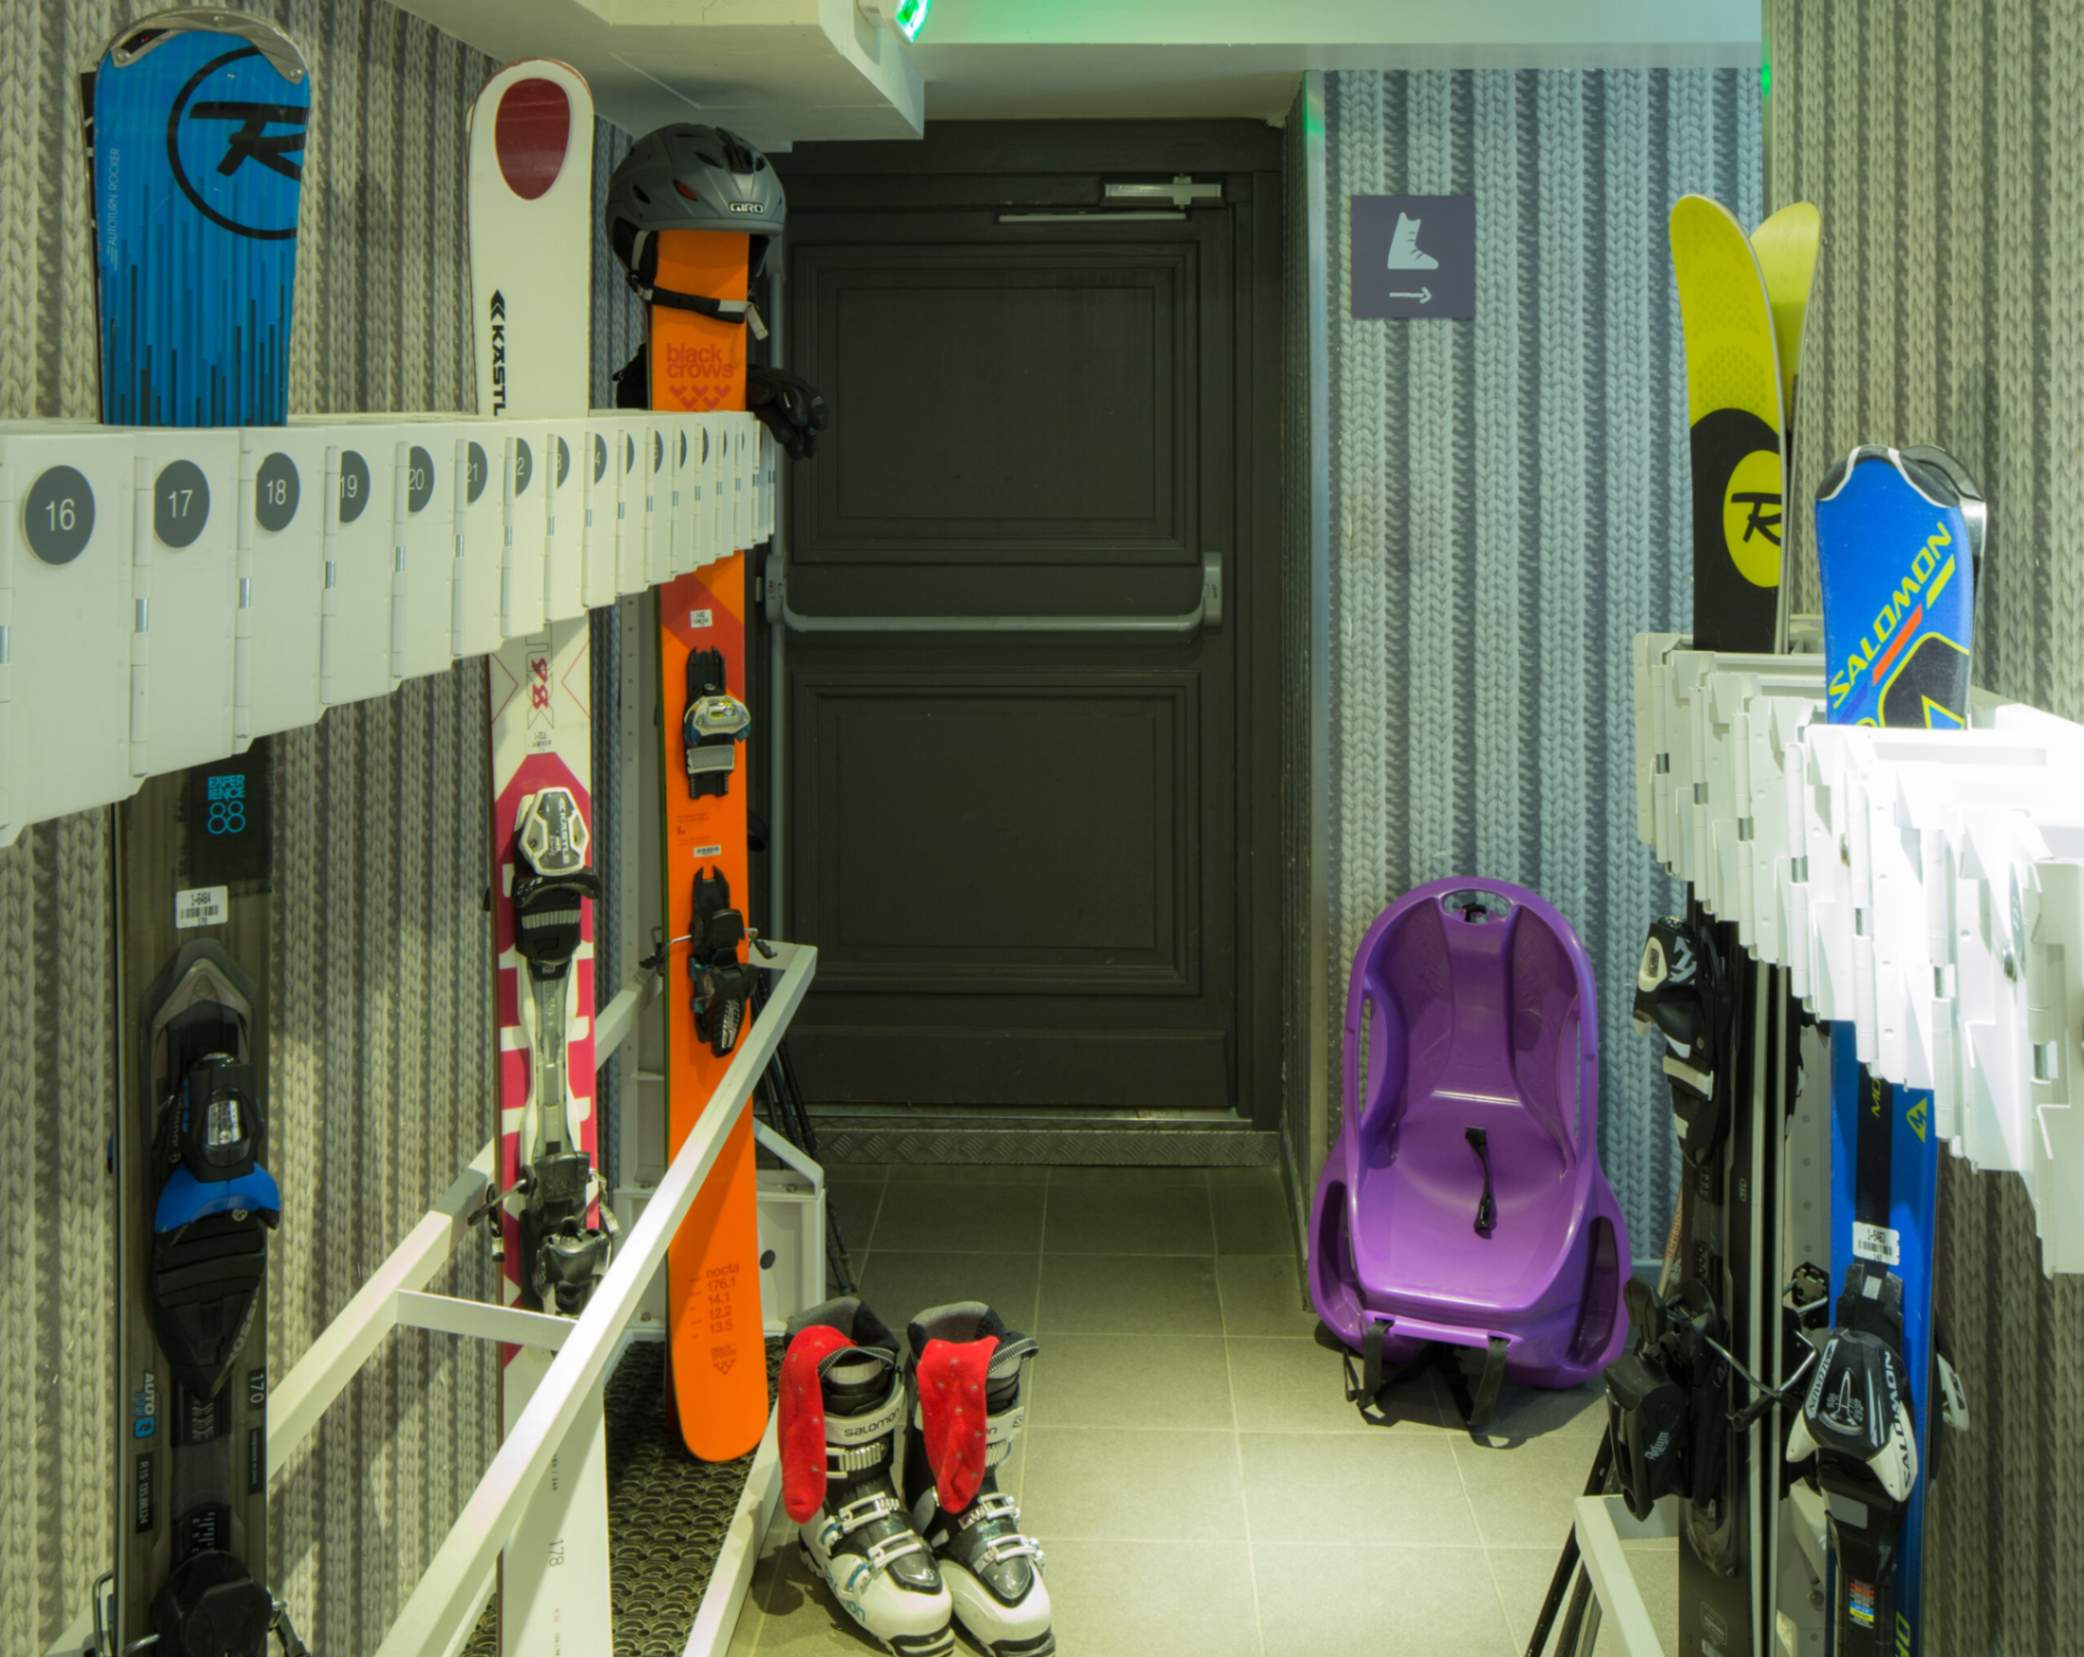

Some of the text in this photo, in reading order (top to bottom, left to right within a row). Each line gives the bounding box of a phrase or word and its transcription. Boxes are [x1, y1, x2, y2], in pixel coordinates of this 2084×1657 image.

[729, 202, 764, 215] GIRO
[666, 343, 723, 363] black
[491, 324, 506, 417] KASTL
[666, 362, 735, 379] crows
[407, 467, 425, 491] 20
[514, 456, 526, 476] 2
[265, 478, 288, 506] 18
[340, 473, 358, 499] 19
[45, 497, 77, 532] 16
[167, 488, 194, 519] 17
[1828, 521, 1952, 710] SALOMON
[207, 800, 247, 835] 88
[705, 1263, 740, 1279] nocta
[144, 1372, 155, 1415] AUTO
[249, 1372, 265, 1405] 170
[1884, 1350, 1911, 1489] SALOMON
[548, 1538, 565, 1568] 178
